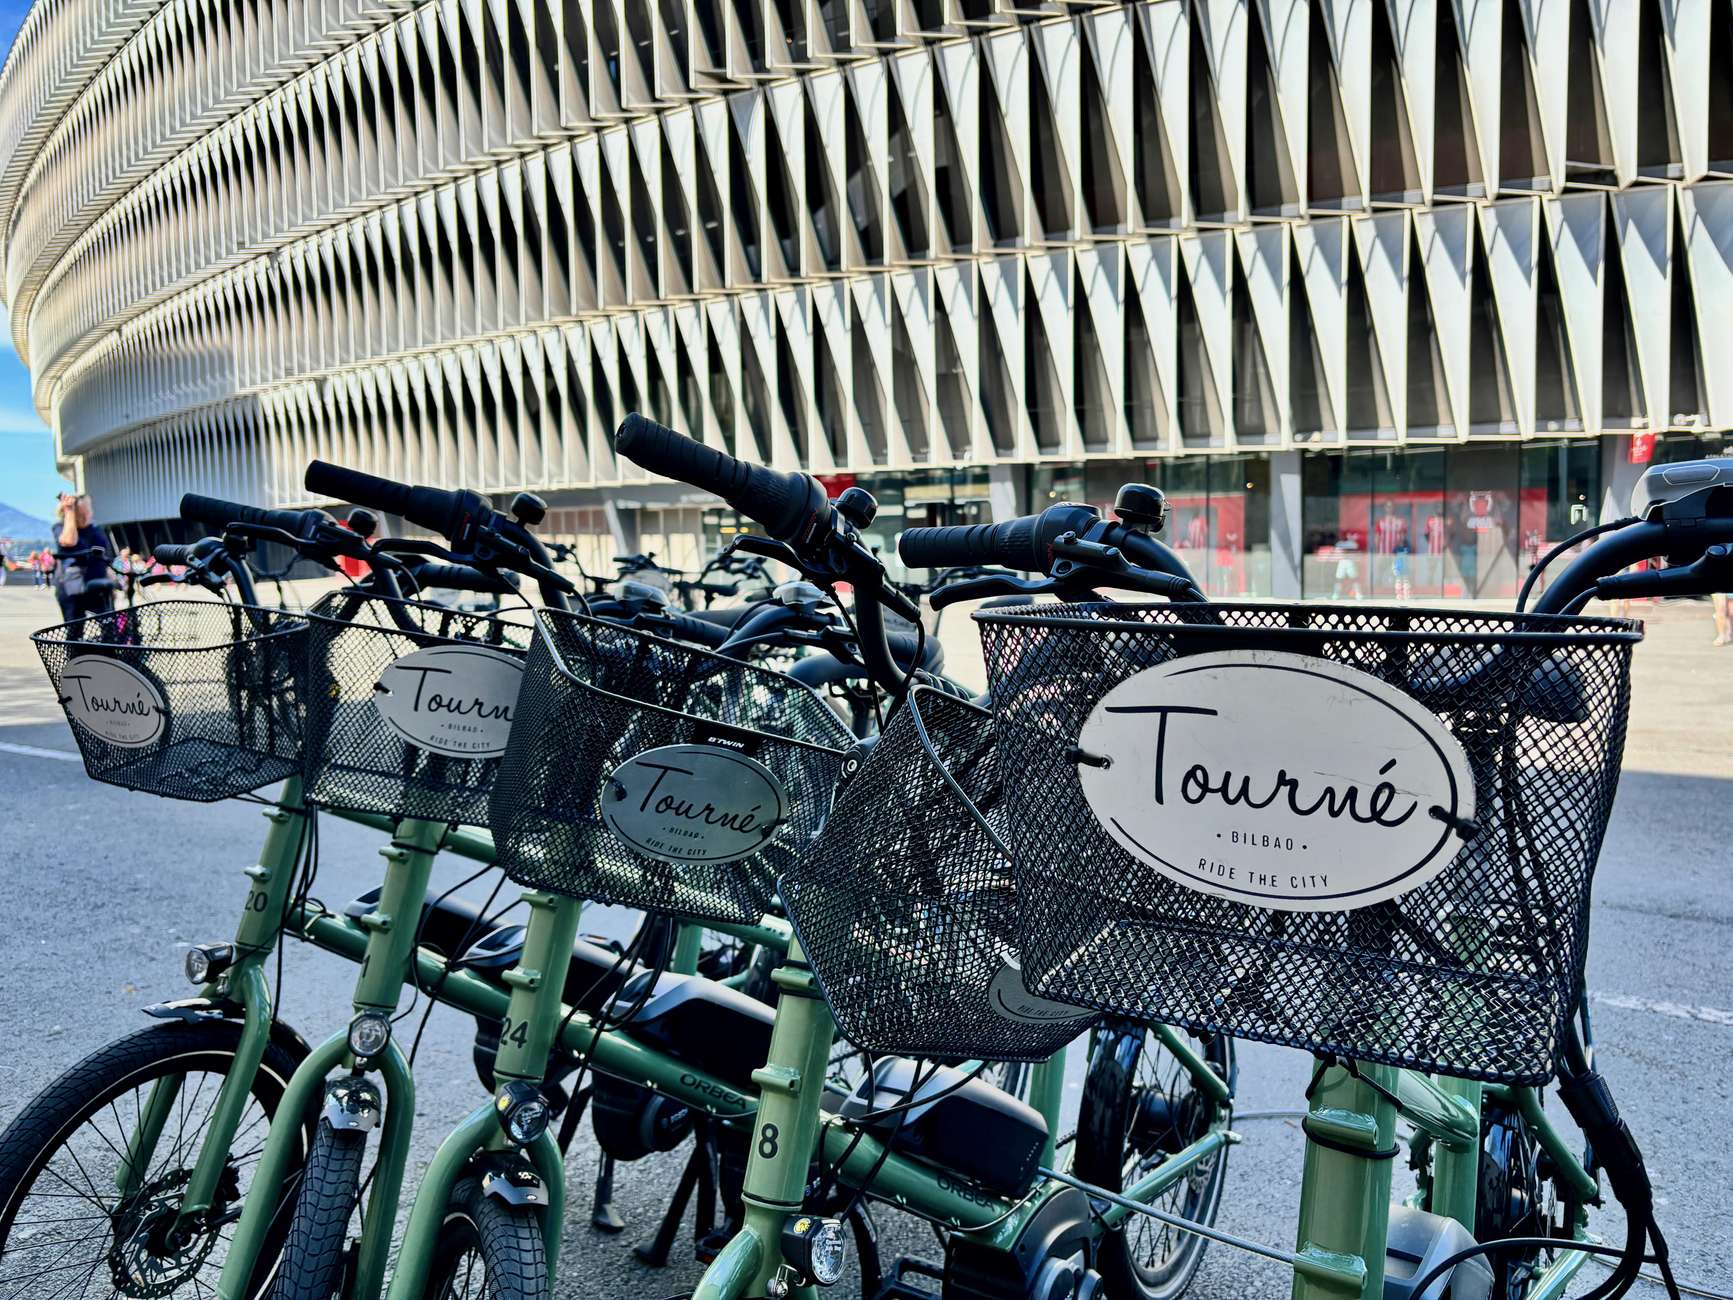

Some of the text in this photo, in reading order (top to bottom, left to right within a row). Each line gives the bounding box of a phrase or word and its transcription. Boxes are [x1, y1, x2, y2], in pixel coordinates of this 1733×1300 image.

[62, 675, 151, 717] Tourné
[395, 665, 515, 722] Tourn
[1104, 705, 1418, 828] Tourné
[635, 761, 762, 834] Tourné
[1231, 830, 1294, 851] BILBAO
[1198, 857, 1329, 889] RIDE THE CITY
[244, 890, 269, 913] 20
[500, 1016, 529, 1049] 24
[680, 1072, 747, 1110] ORBEA
[758, 1122, 779, 1160] 8
